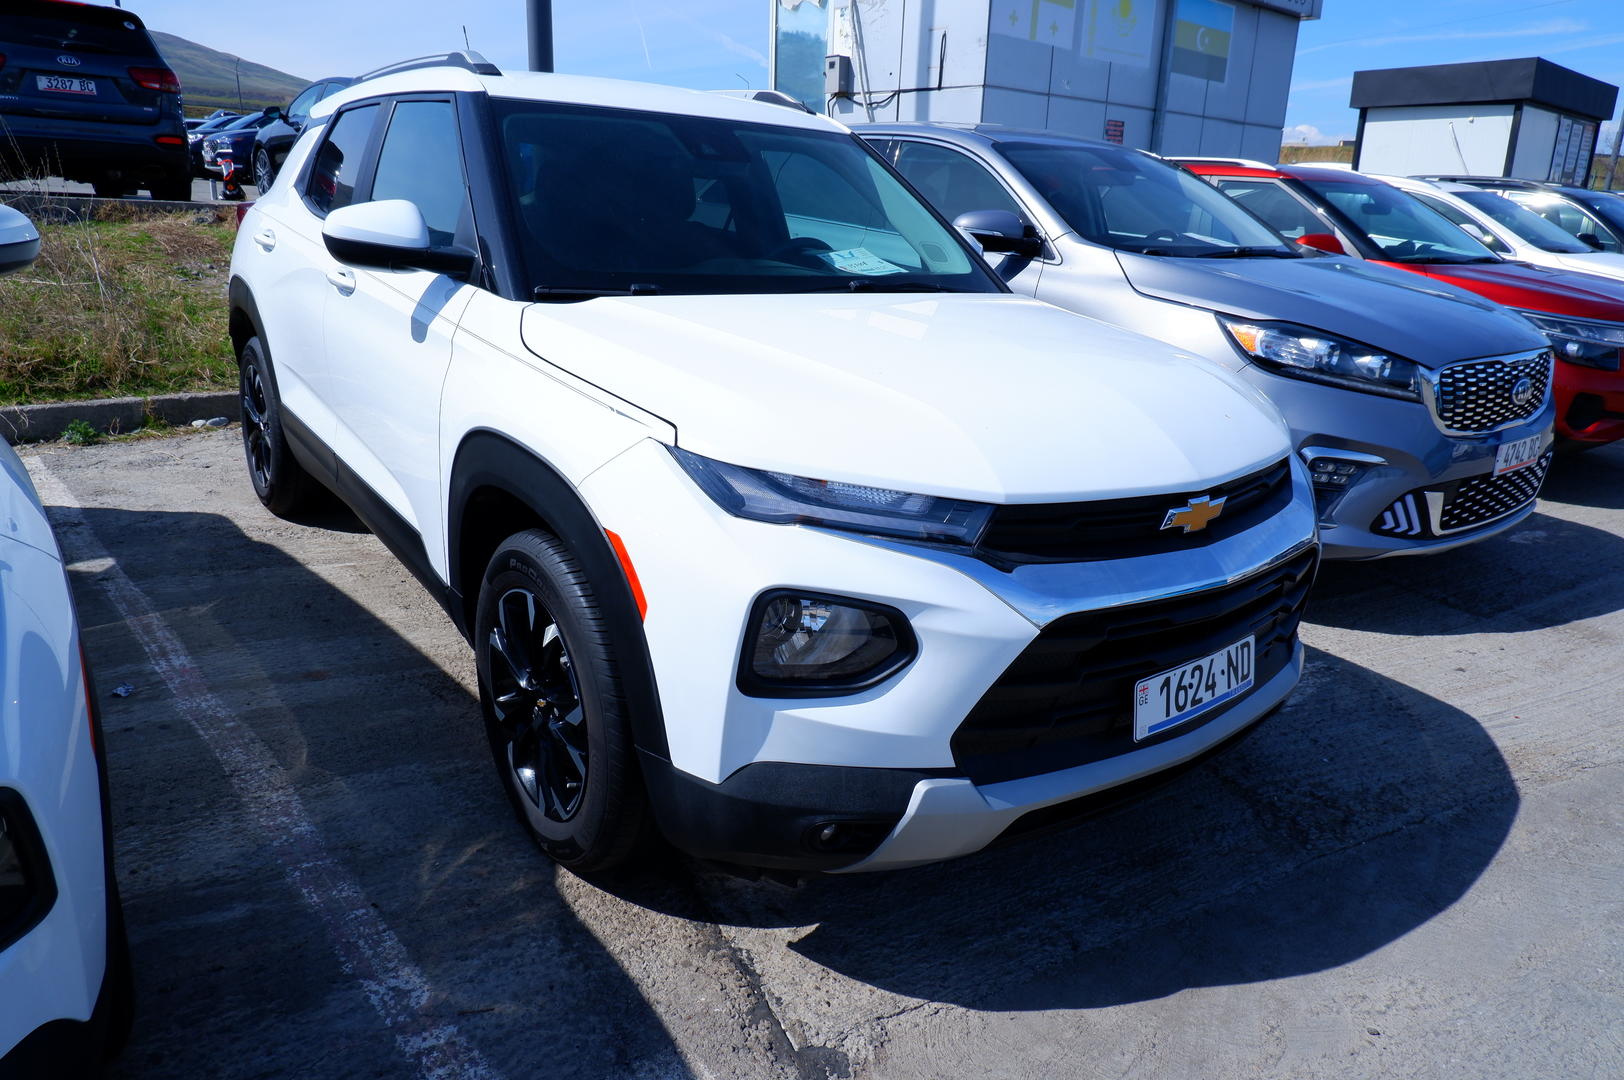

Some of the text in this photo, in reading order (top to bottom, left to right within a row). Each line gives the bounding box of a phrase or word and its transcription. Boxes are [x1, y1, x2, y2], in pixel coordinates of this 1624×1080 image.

[46, 76, 95, 93] 3287 BC
[1503, 440, 1527, 467] 4742
[1159, 657, 1217, 718] 1624
[1138, 693, 1149, 706] GE
